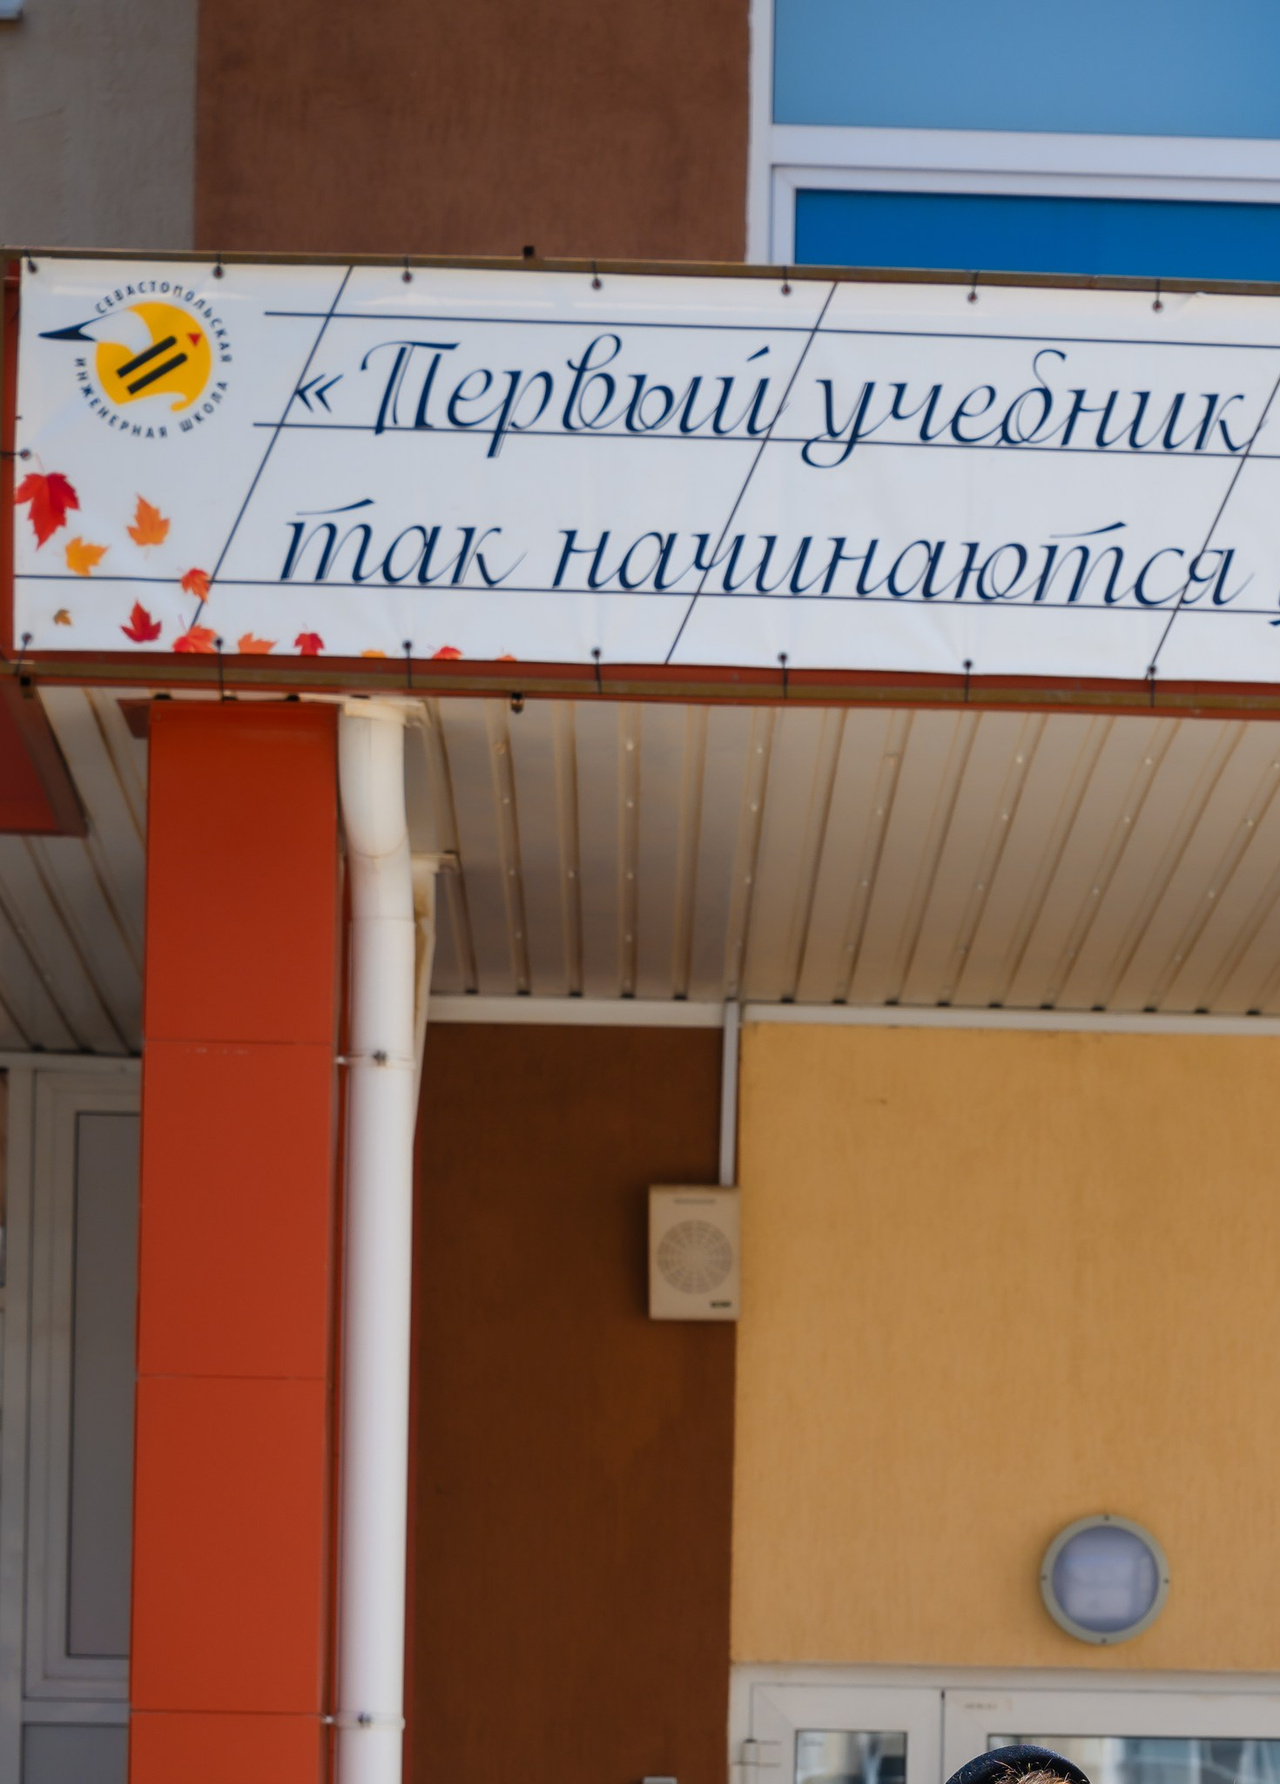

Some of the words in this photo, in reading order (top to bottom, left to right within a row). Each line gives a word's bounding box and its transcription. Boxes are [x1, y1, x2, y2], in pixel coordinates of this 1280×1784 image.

[95, 281, 232, 362] СЕВАСТОПОЛЬСКАЯ
[75, 357, 168, 438] ИНЖЕНЕРНАЯ
[179, 381, 228, 432] ШКОЛА
[294, 333, 789, 458] «Первый
[801, 349, 1267, 468] учебник
[279, 498, 527, 585] так
[551, 521, 1255, 606] начинаются
